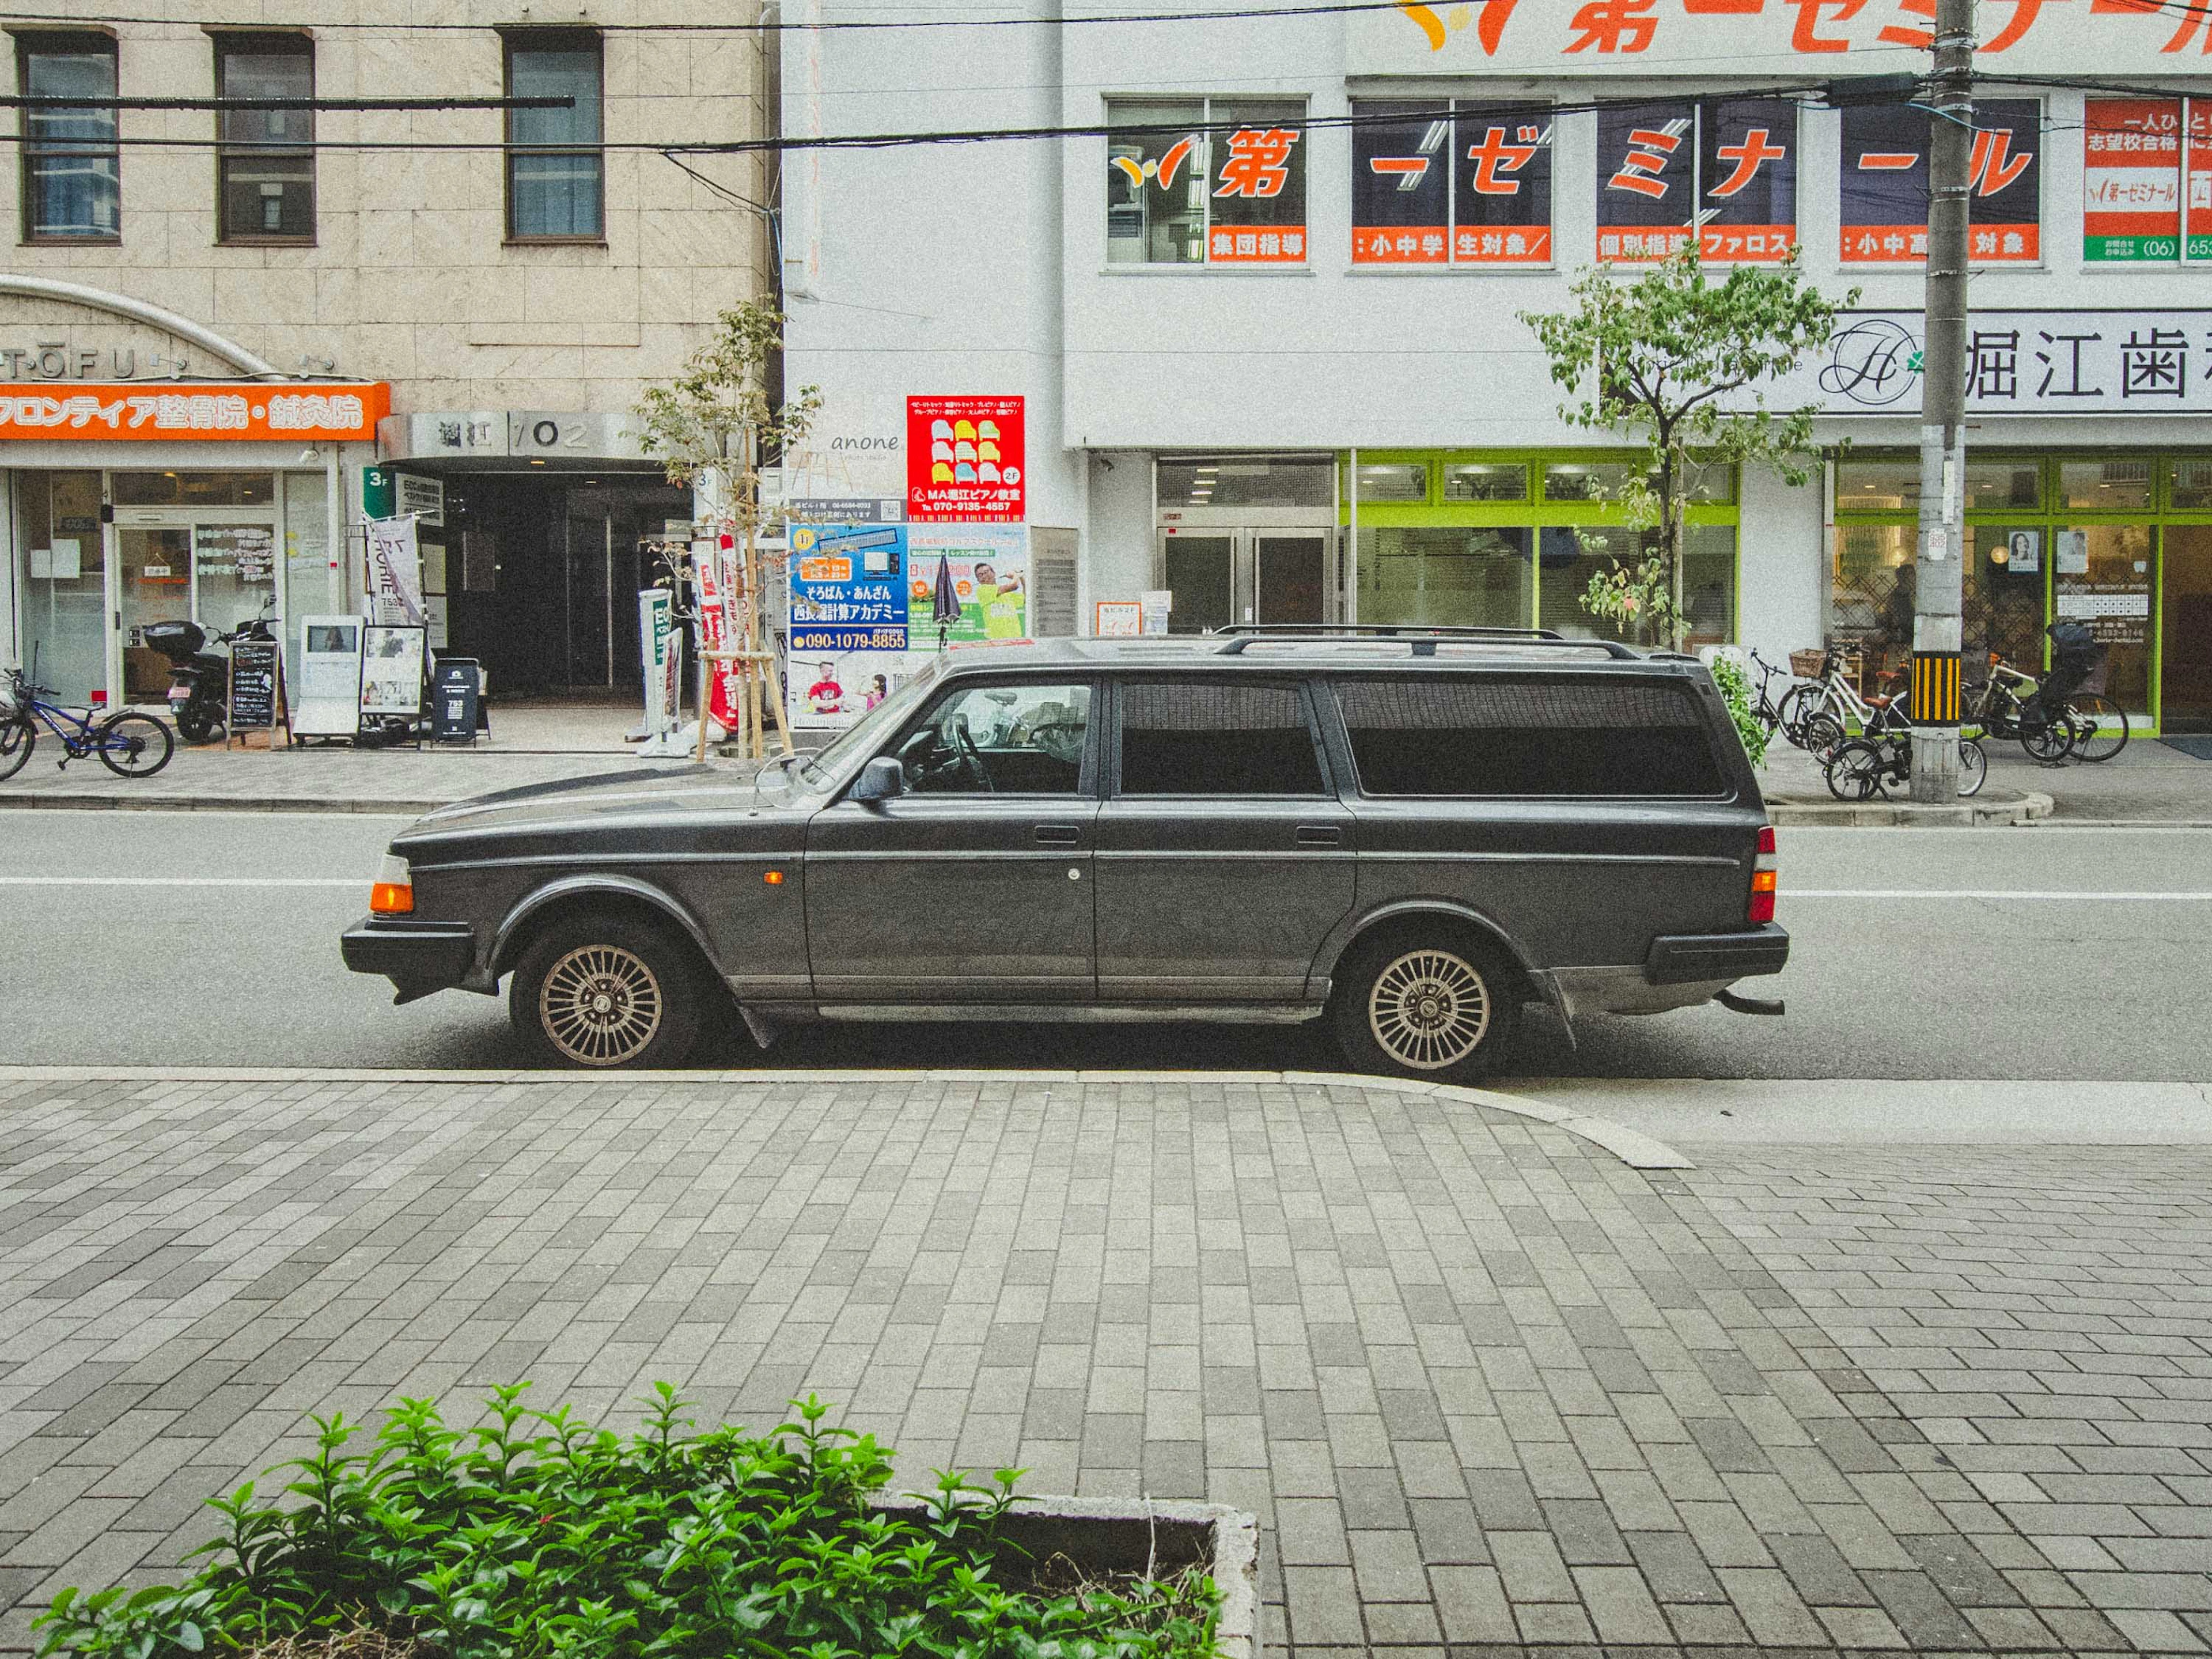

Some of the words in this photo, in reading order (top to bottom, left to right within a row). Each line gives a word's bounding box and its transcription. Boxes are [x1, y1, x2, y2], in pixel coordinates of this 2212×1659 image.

[2124, 113, 2212, 131] 一人ひと
[2108, 182, 2175, 202] 第一ゼミナール
[1213, 234, 1304, 255] 集団指導
[1844, 233, 2024, 255] :小中高対象
[831, 437, 899, 450] anone
[806, 586, 891, 600] そろばん・あんざん
[806, 634, 905, 648] 090-1079-8855
